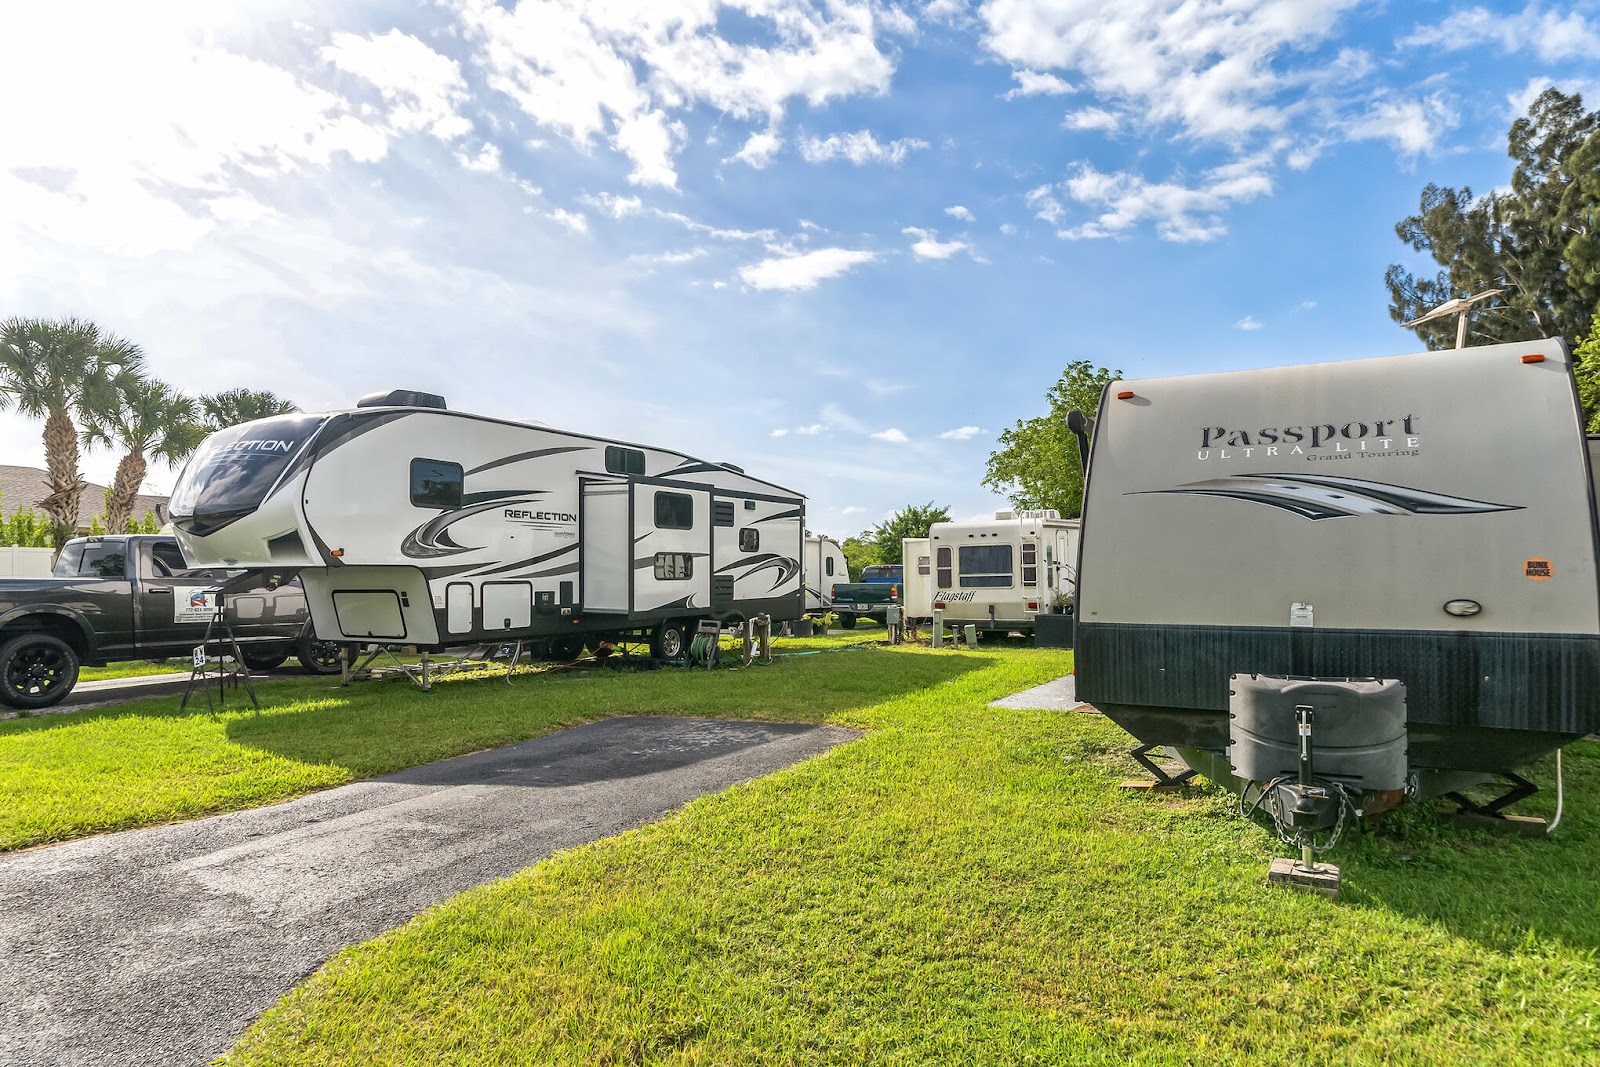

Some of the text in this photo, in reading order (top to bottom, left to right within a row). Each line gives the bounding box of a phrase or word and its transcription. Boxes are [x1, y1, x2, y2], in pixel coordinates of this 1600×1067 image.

[1199, 413, 1420, 449] Passport
[1197, 437, 1420, 461] ULTRA LITE
[1306, 448, 1420, 462] Grand Touring
[504, 509, 577, 522] REFLECTION
[933, 591, 977, 602] Flagstaff
[195, 656, 204, 665] 24
